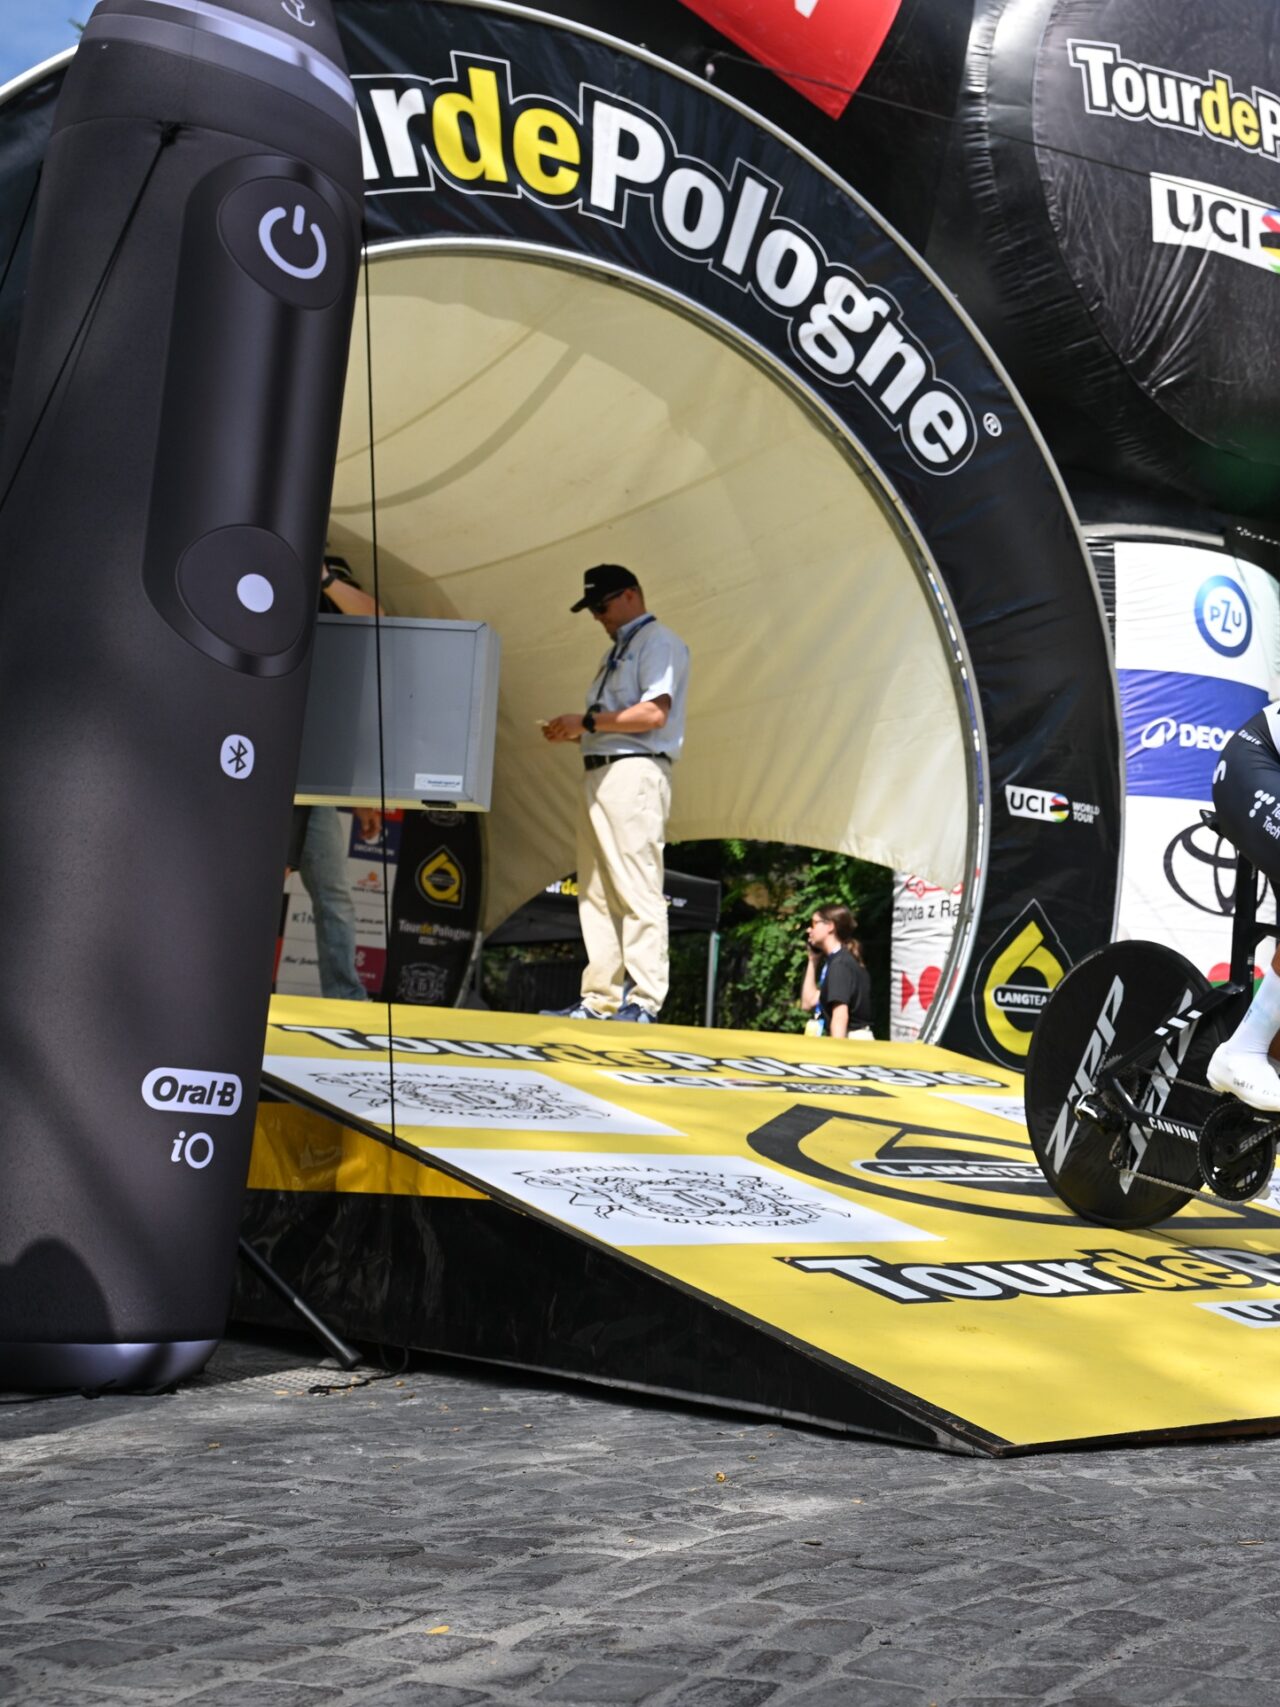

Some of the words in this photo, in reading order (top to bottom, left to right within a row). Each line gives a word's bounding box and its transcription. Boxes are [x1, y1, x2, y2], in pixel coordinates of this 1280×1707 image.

[1166, 188, 1251, 249] UCI
[1209, 600, 1242, 634] PZU
[1010, 791, 1045, 815] UCI
[1072, 801, 1100, 816] WORLD
[1073, 811, 1094, 824] TOUR
[1262, 815, 1280, 840] Tech
[928, 905, 934, 918] z
[398, 919, 472, 941] TourdePologne
[280, 1024, 1005, 1088] TourdePologne
[152, 1073, 237, 1107] Oral-B
[615, 1073, 708, 1088] UCI
[1148, 1116, 1199, 1142] CANYON
[170, 1131, 214, 1170] iO
